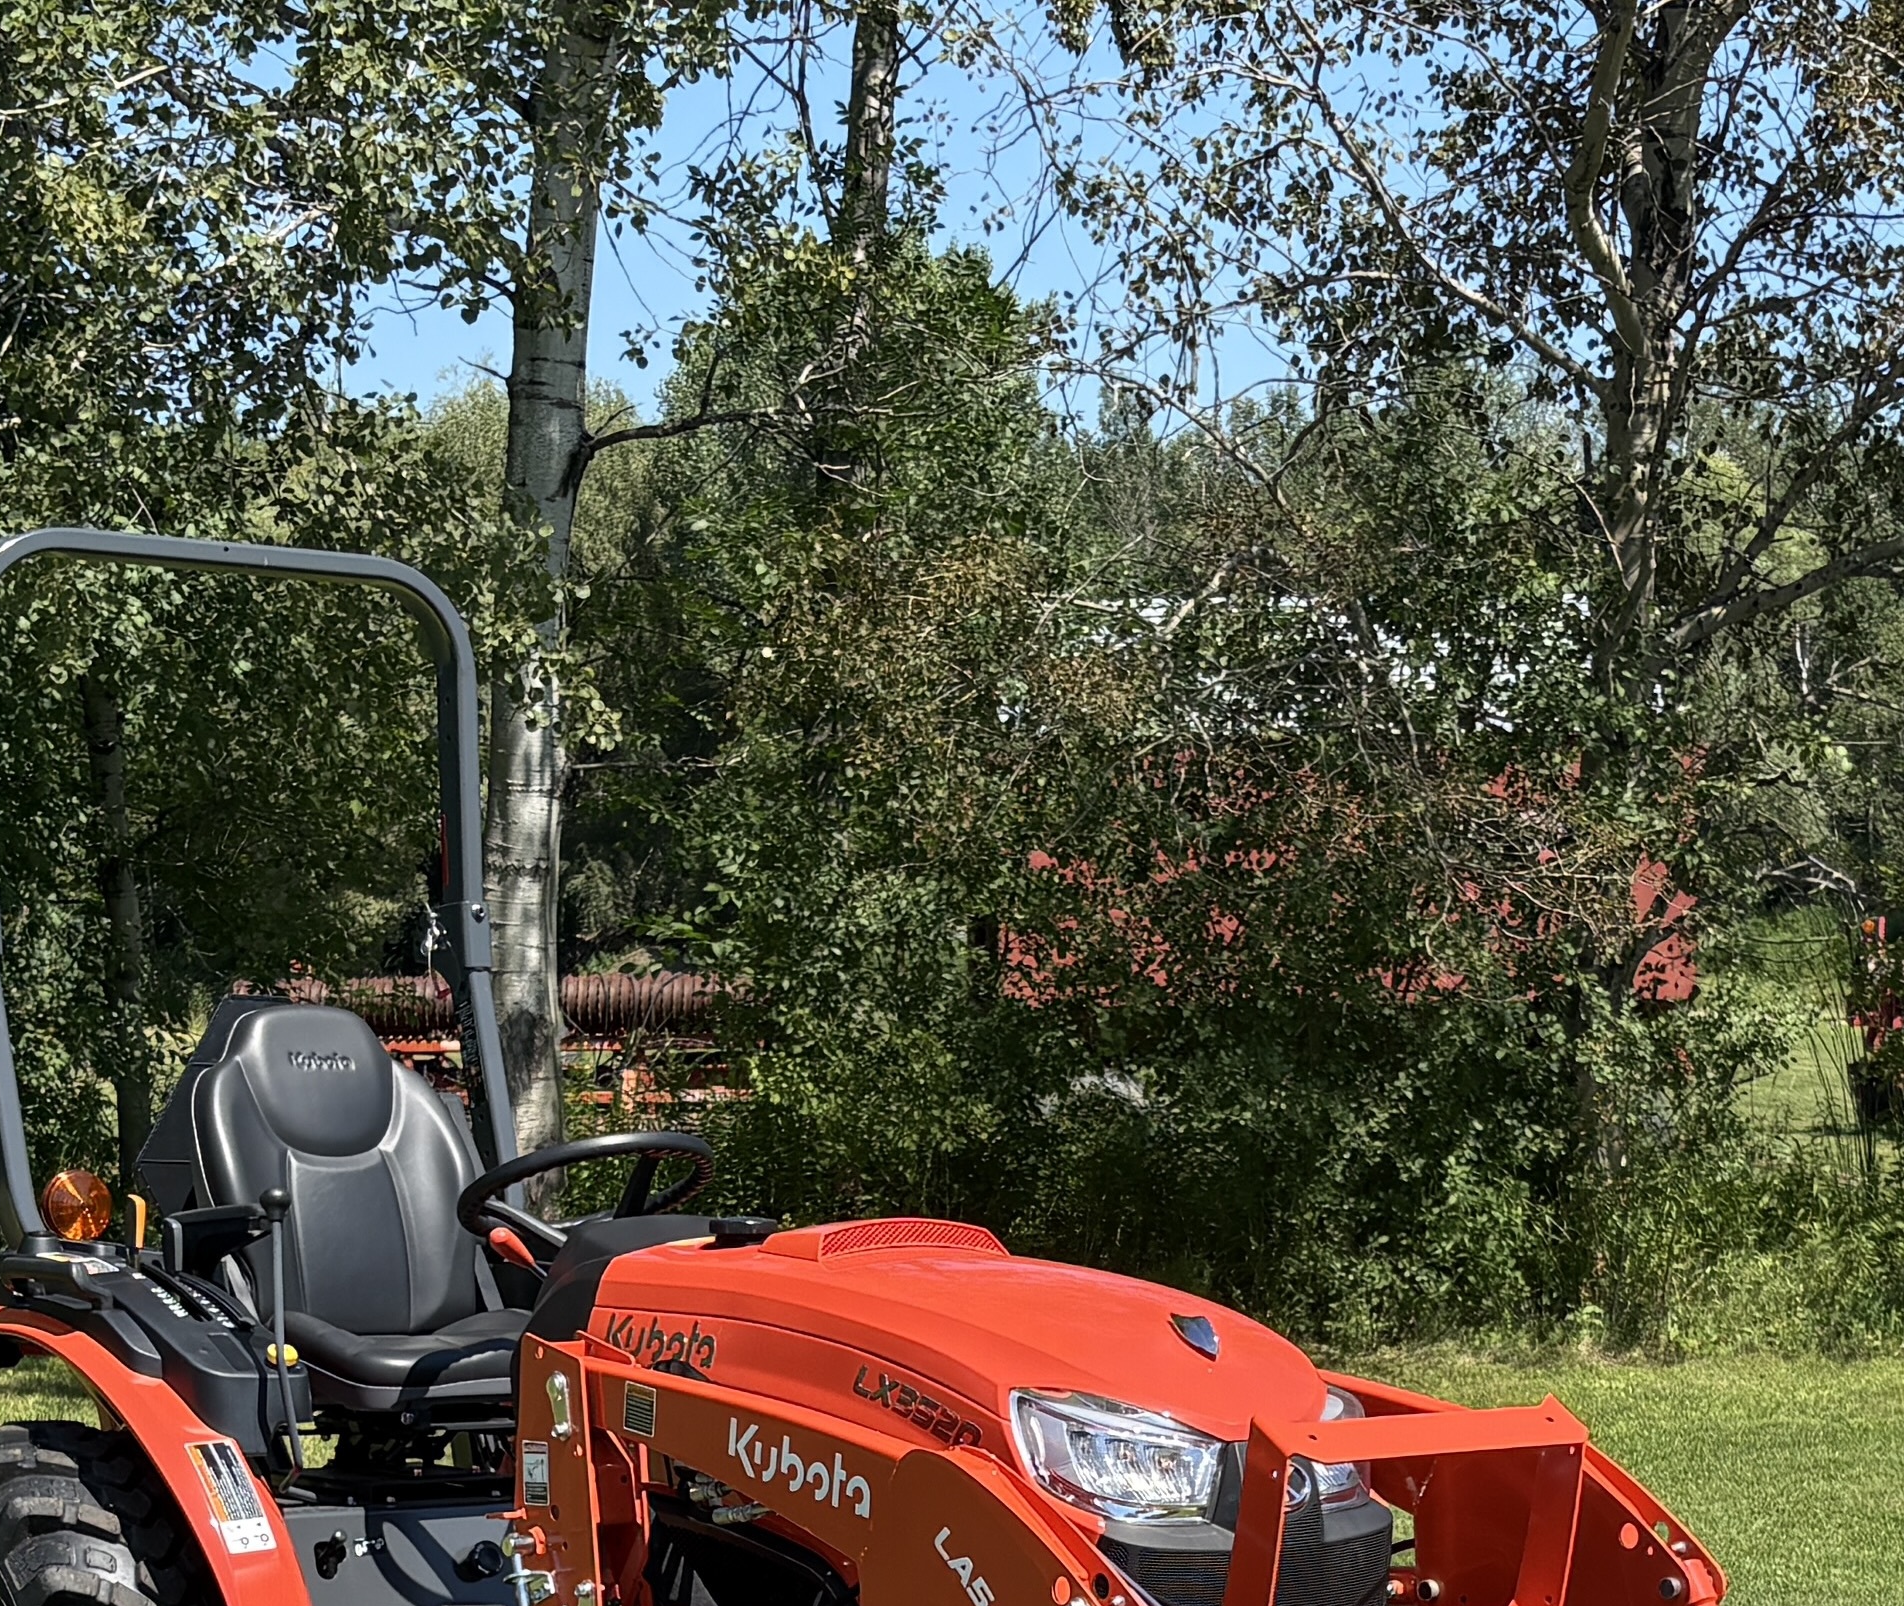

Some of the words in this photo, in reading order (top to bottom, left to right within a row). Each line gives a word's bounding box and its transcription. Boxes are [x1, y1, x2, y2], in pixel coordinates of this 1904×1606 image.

[287, 1050, 356, 1073] Kubota
[606, 1311, 716, 1369] Kubota
[853, 1364, 983, 1447] LX3520
[728, 1416, 871, 1519] Kubota
